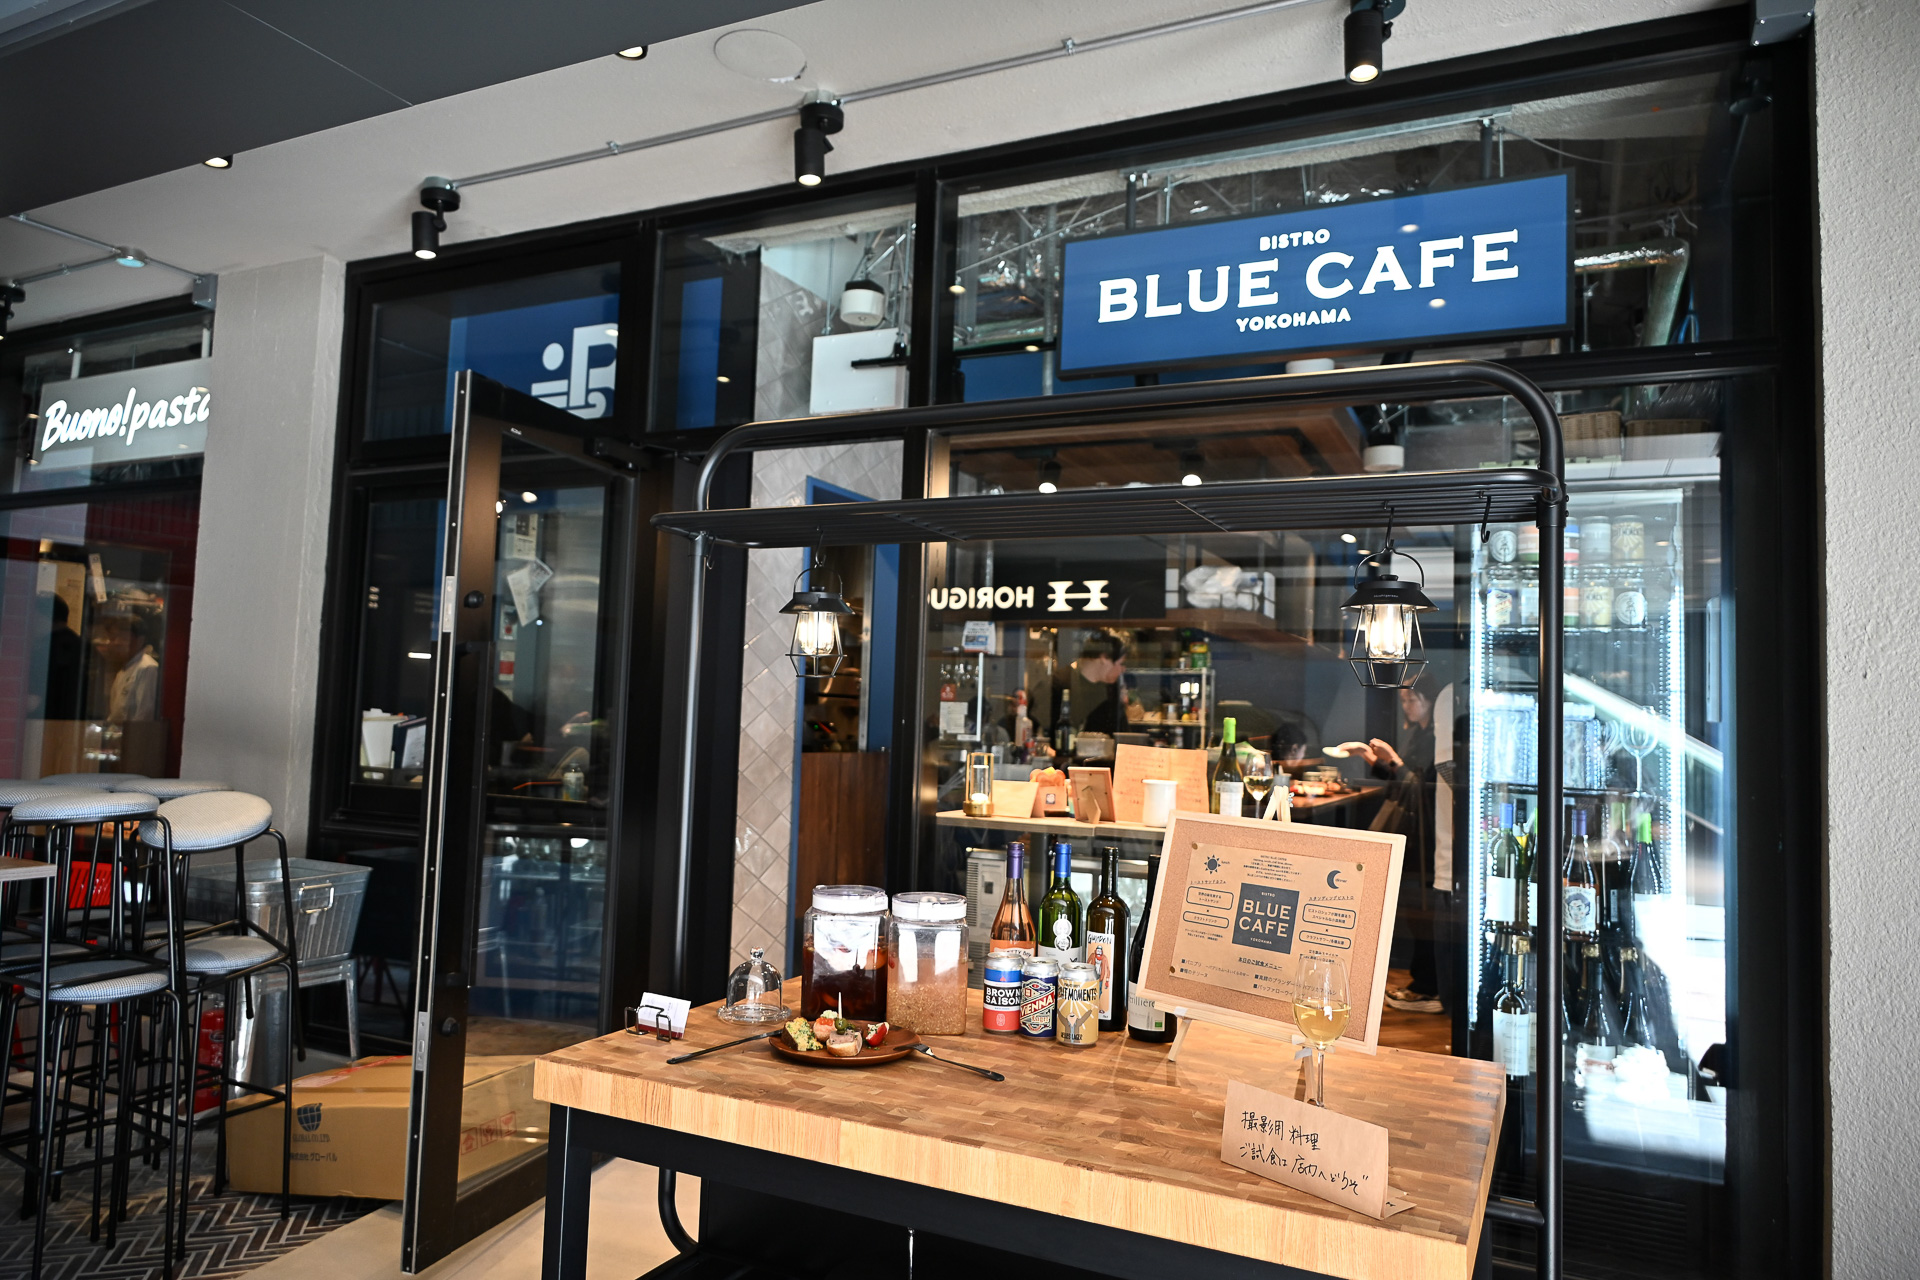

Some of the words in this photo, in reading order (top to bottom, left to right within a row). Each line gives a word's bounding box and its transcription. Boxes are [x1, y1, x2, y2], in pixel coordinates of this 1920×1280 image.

[1259, 228, 1331, 252] BISTRO
[1098, 257, 1279, 323] BLUE
[1305, 228, 1519, 300] CAFE
[1236, 307, 1351, 333] YOKOHAMA
[1242, 899, 1292, 920] BLUE
[1239, 916, 1289, 938] CAFE
[1250, 937, 1272, 945] YOKOHAMA
[985, 996, 1021, 1006] SAISON
[986, 987, 1021, 998] BROWN
[1289, 1125, 1320, 1150] 料理
[310, 1152, 338, 1162] グローバル
